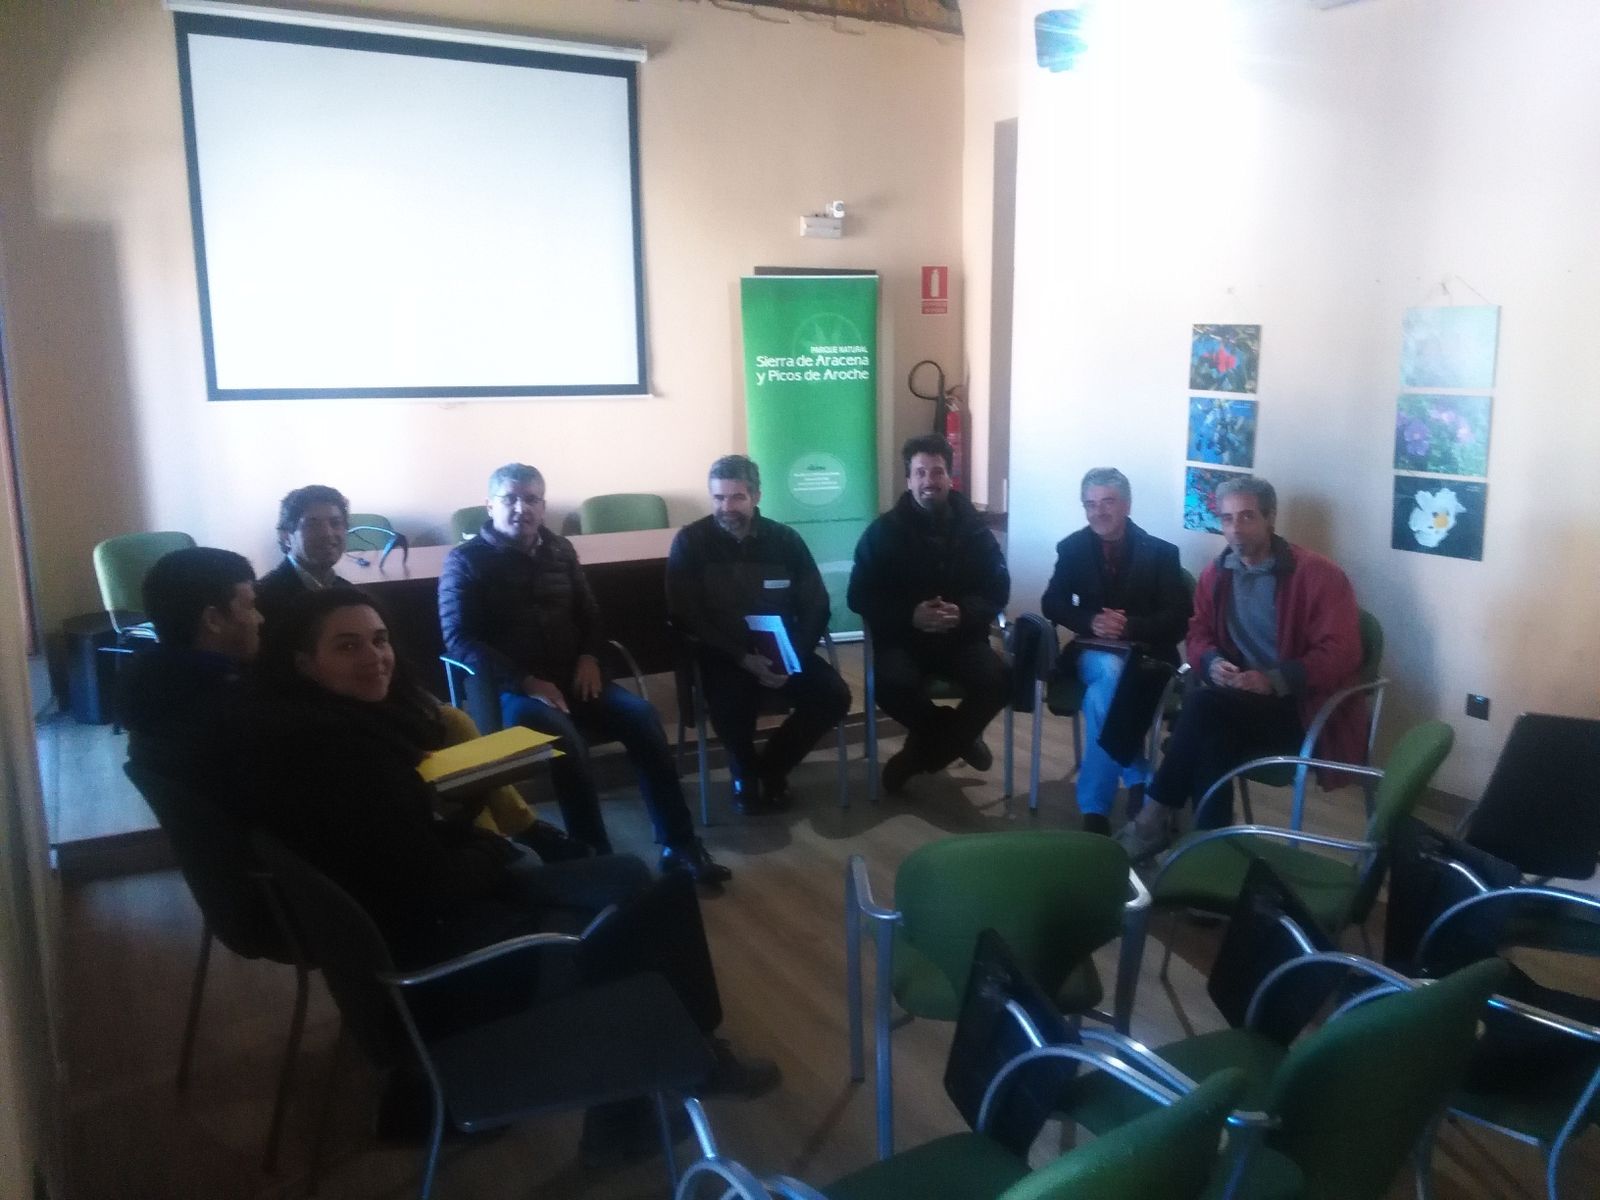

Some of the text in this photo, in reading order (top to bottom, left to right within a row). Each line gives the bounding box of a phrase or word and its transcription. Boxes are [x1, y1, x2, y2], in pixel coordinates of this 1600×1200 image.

[839, 345, 868, 353] NATURAL
[756, 355, 869, 367] Sierra de Aracena
[756, 369, 869, 386] y Picos de Aroche
